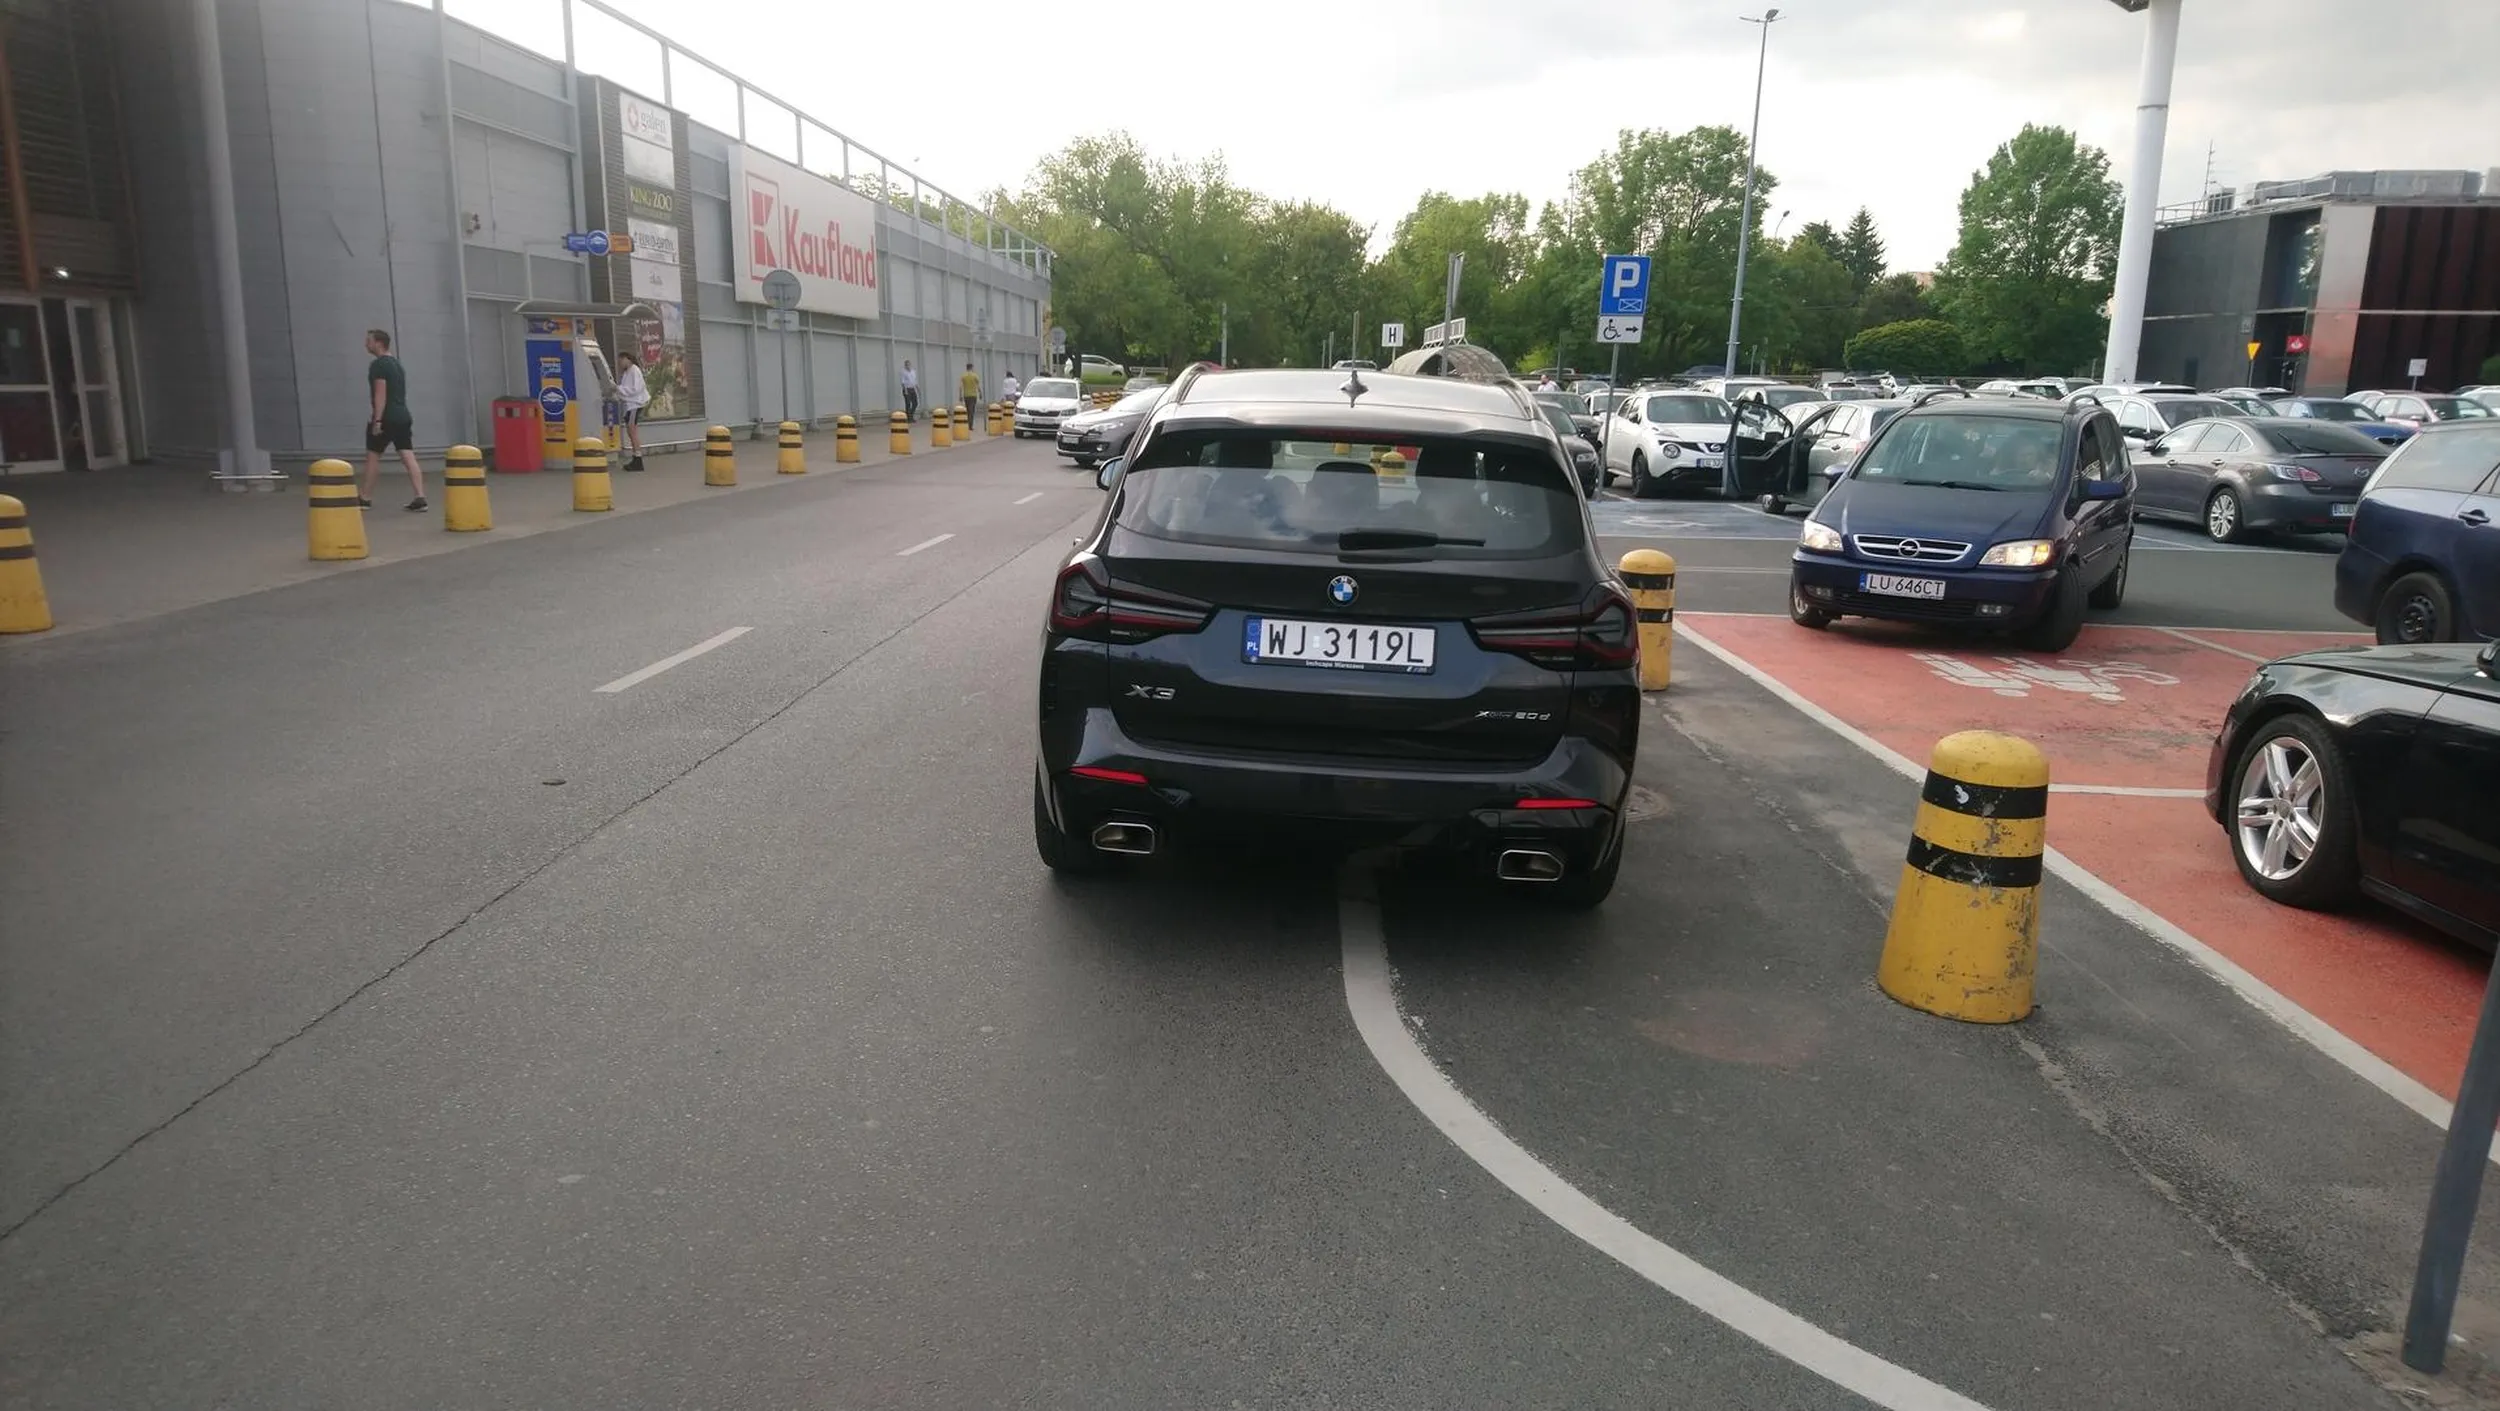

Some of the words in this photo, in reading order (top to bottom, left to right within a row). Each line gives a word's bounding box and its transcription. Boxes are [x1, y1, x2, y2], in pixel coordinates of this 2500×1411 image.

[653, 191, 673, 211] ZOO
[784, 204, 876, 289] Kaufland
[1612, 261, 1641, 298] P
[1388, 326, 1397, 343] H
[1869, 575, 1891, 590] LU
[1895, 578, 1944, 595] 646CT
[1246, 641, 1259, 651] PL
[1268, 623, 1307, 656] WJ
[1322, 627, 1425, 664] 3119L
[1123, 684, 1176, 700] X3
